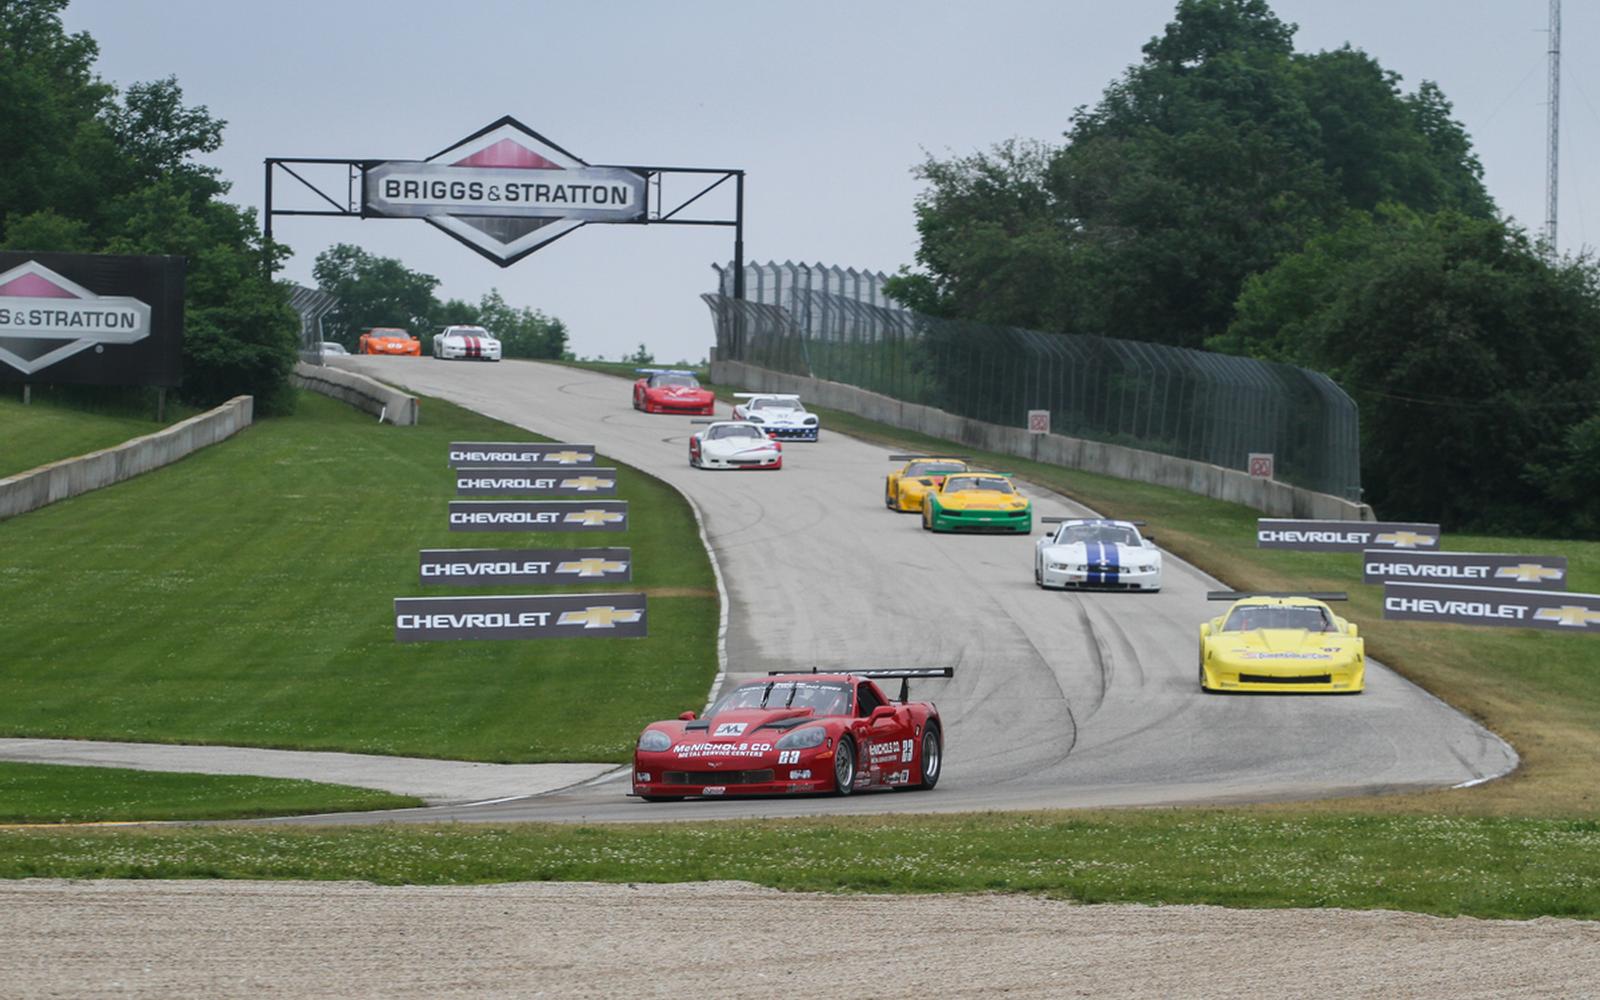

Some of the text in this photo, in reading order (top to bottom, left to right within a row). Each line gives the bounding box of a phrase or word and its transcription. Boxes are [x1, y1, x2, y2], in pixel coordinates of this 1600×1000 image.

[29, 310, 135, 329] STRATTON
[450, 451, 540, 462] CHEVROLET
[457, 478, 557, 489] CHEVROLET
[450, 512, 560, 524] CHEVROLET
[1258, 530, 1371, 544] CHEVROLET
[421, 561, 551, 576] CHEVROLET
[1366, 562, 1490, 579] CHEVROLET
[1385, 597, 1528, 620] CHEVROLET
[396, 612, 551, 630] CHEVROLET
[751, 743, 773, 752] CO.
